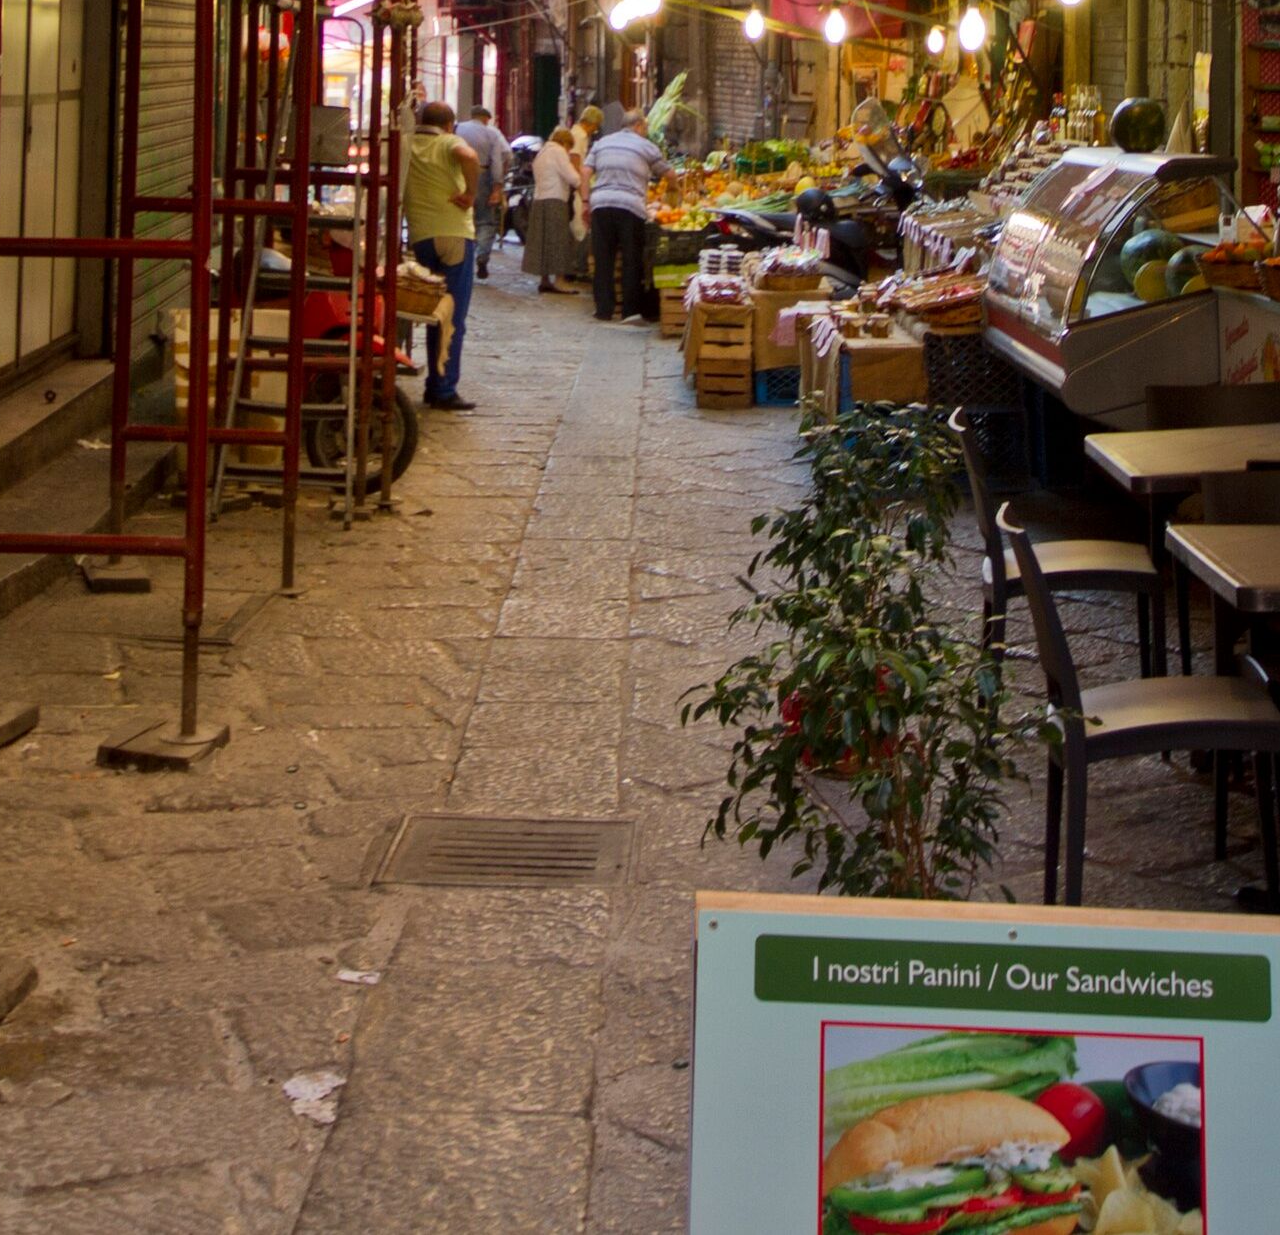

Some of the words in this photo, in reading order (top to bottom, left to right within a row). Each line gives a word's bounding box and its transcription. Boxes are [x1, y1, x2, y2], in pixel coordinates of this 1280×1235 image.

[812, 955, 820, 982] I
[827, 960, 899, 985] nostri
[908, 959, 981, 988] Panini
[987, 962, 999, 992] /
[1006, 963, 1060, 991] Our
[1066, 965, 1214, 999] Sandwiches
